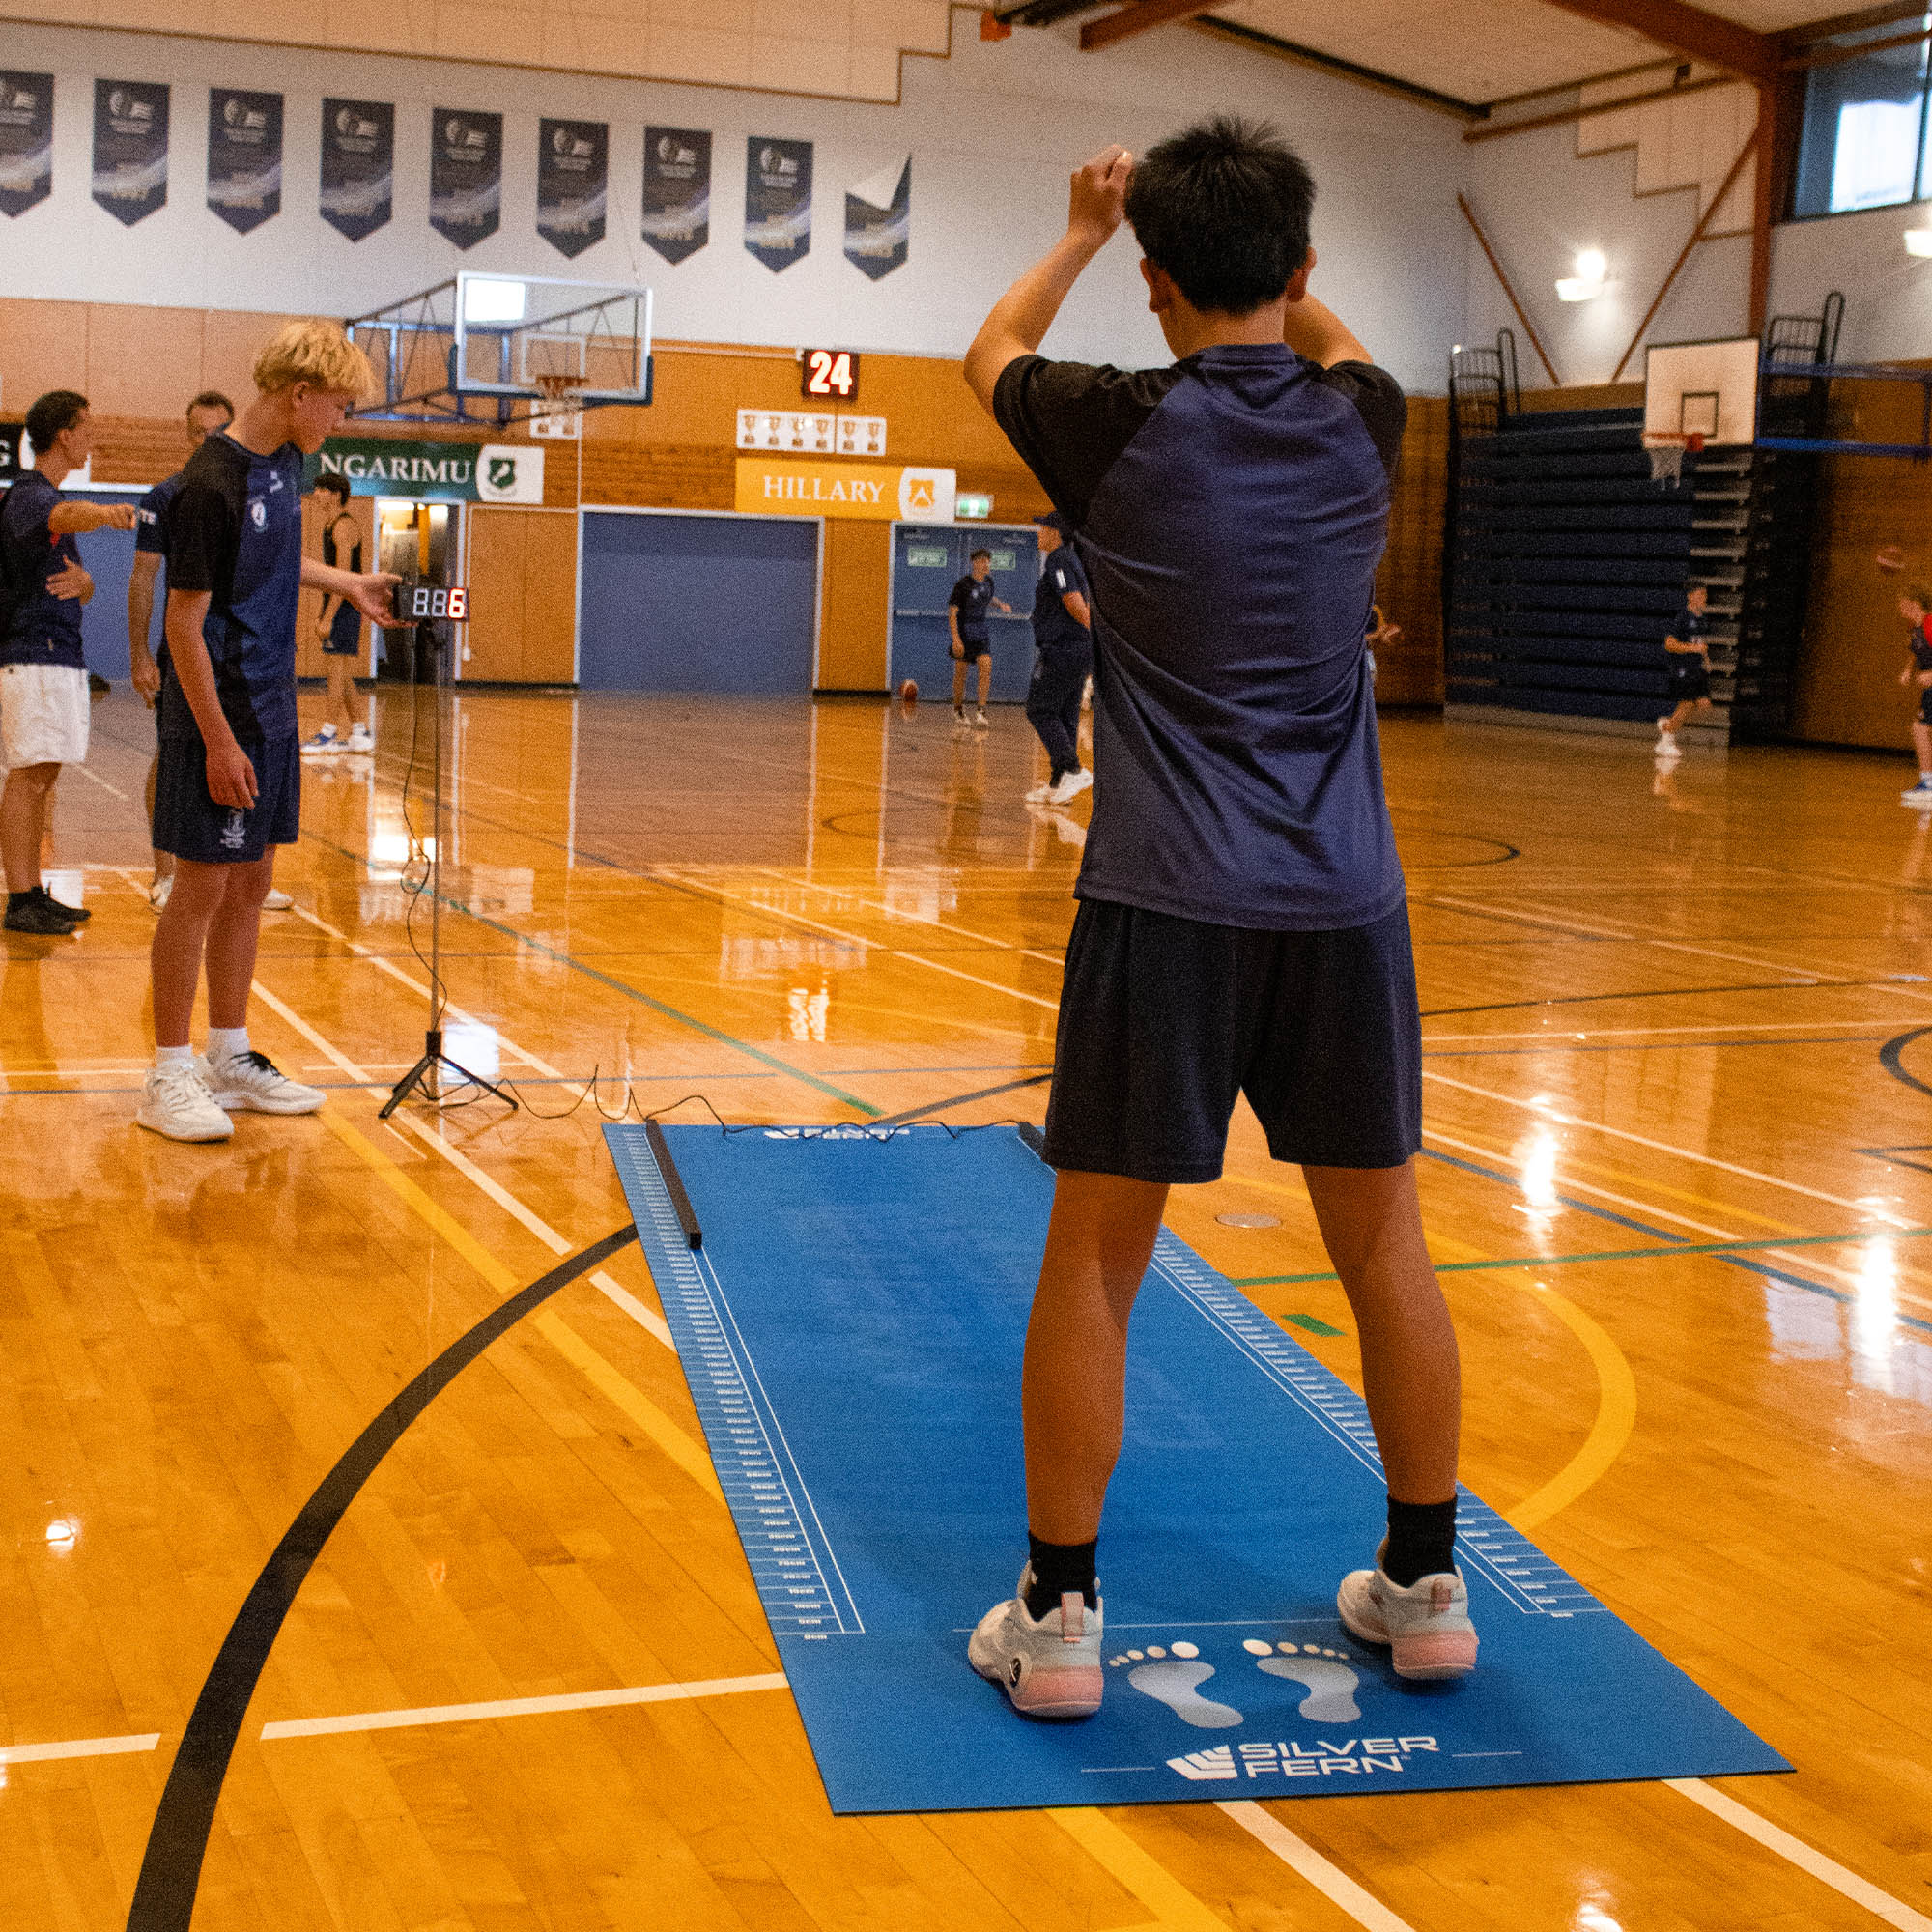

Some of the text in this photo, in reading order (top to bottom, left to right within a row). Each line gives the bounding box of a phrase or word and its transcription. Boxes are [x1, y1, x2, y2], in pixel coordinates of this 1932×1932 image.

[808, 349, 853, 395] 24
[320, 452, 471, 484] NGARIMU
[763, 474, 886, 503] HILLARY
[1238, 1736, 1440, 1760] SILVER
[1244, 1755, 1404, 1778] FERN
